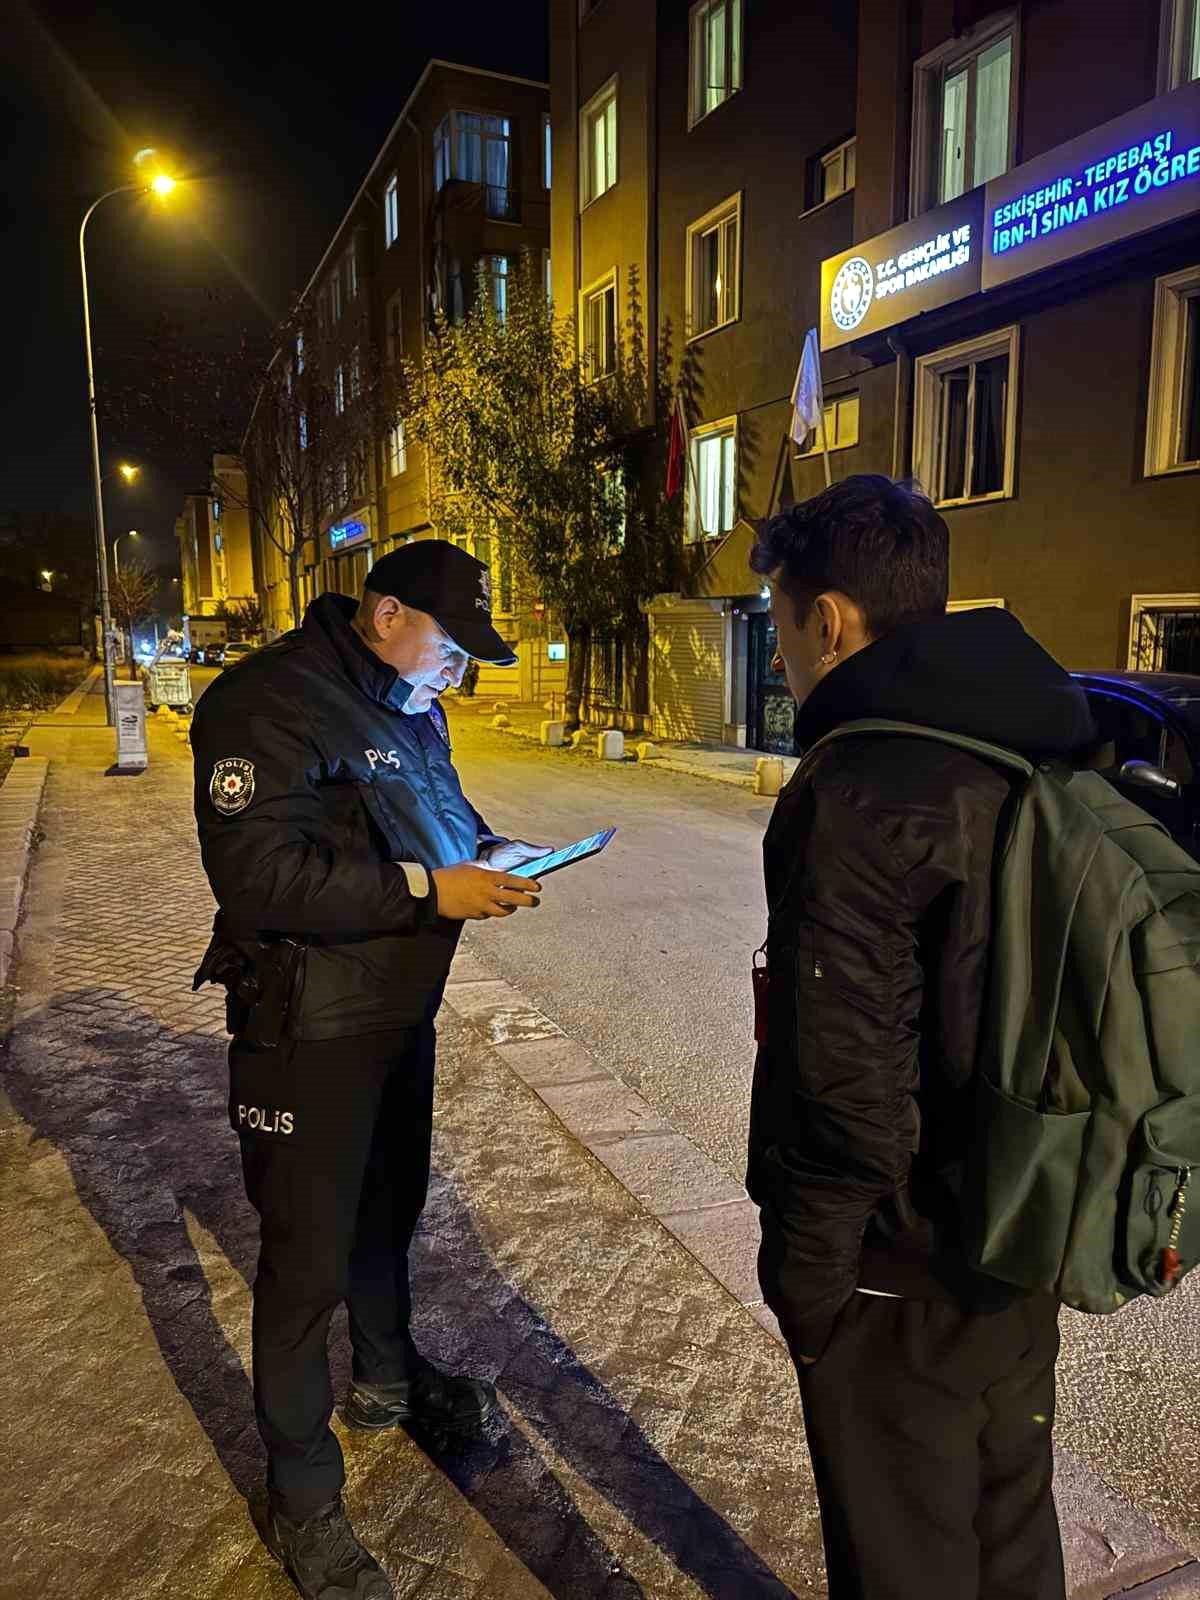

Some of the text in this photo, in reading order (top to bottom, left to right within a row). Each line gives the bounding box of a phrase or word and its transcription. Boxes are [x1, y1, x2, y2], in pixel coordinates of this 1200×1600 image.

[993, 177, 1073, 228] ESKİŞEHİR
[1085, 131, 1172, 187] TEPEBAŞI
[952, 224, 971, 245] VE
[993, 213, 1038, 254] İBN-İ
[1041, 196, 1089, 235] SİNA
[1094, 177, 1130, 213] KIZ
[875, 273, 905, 299] SPOR
